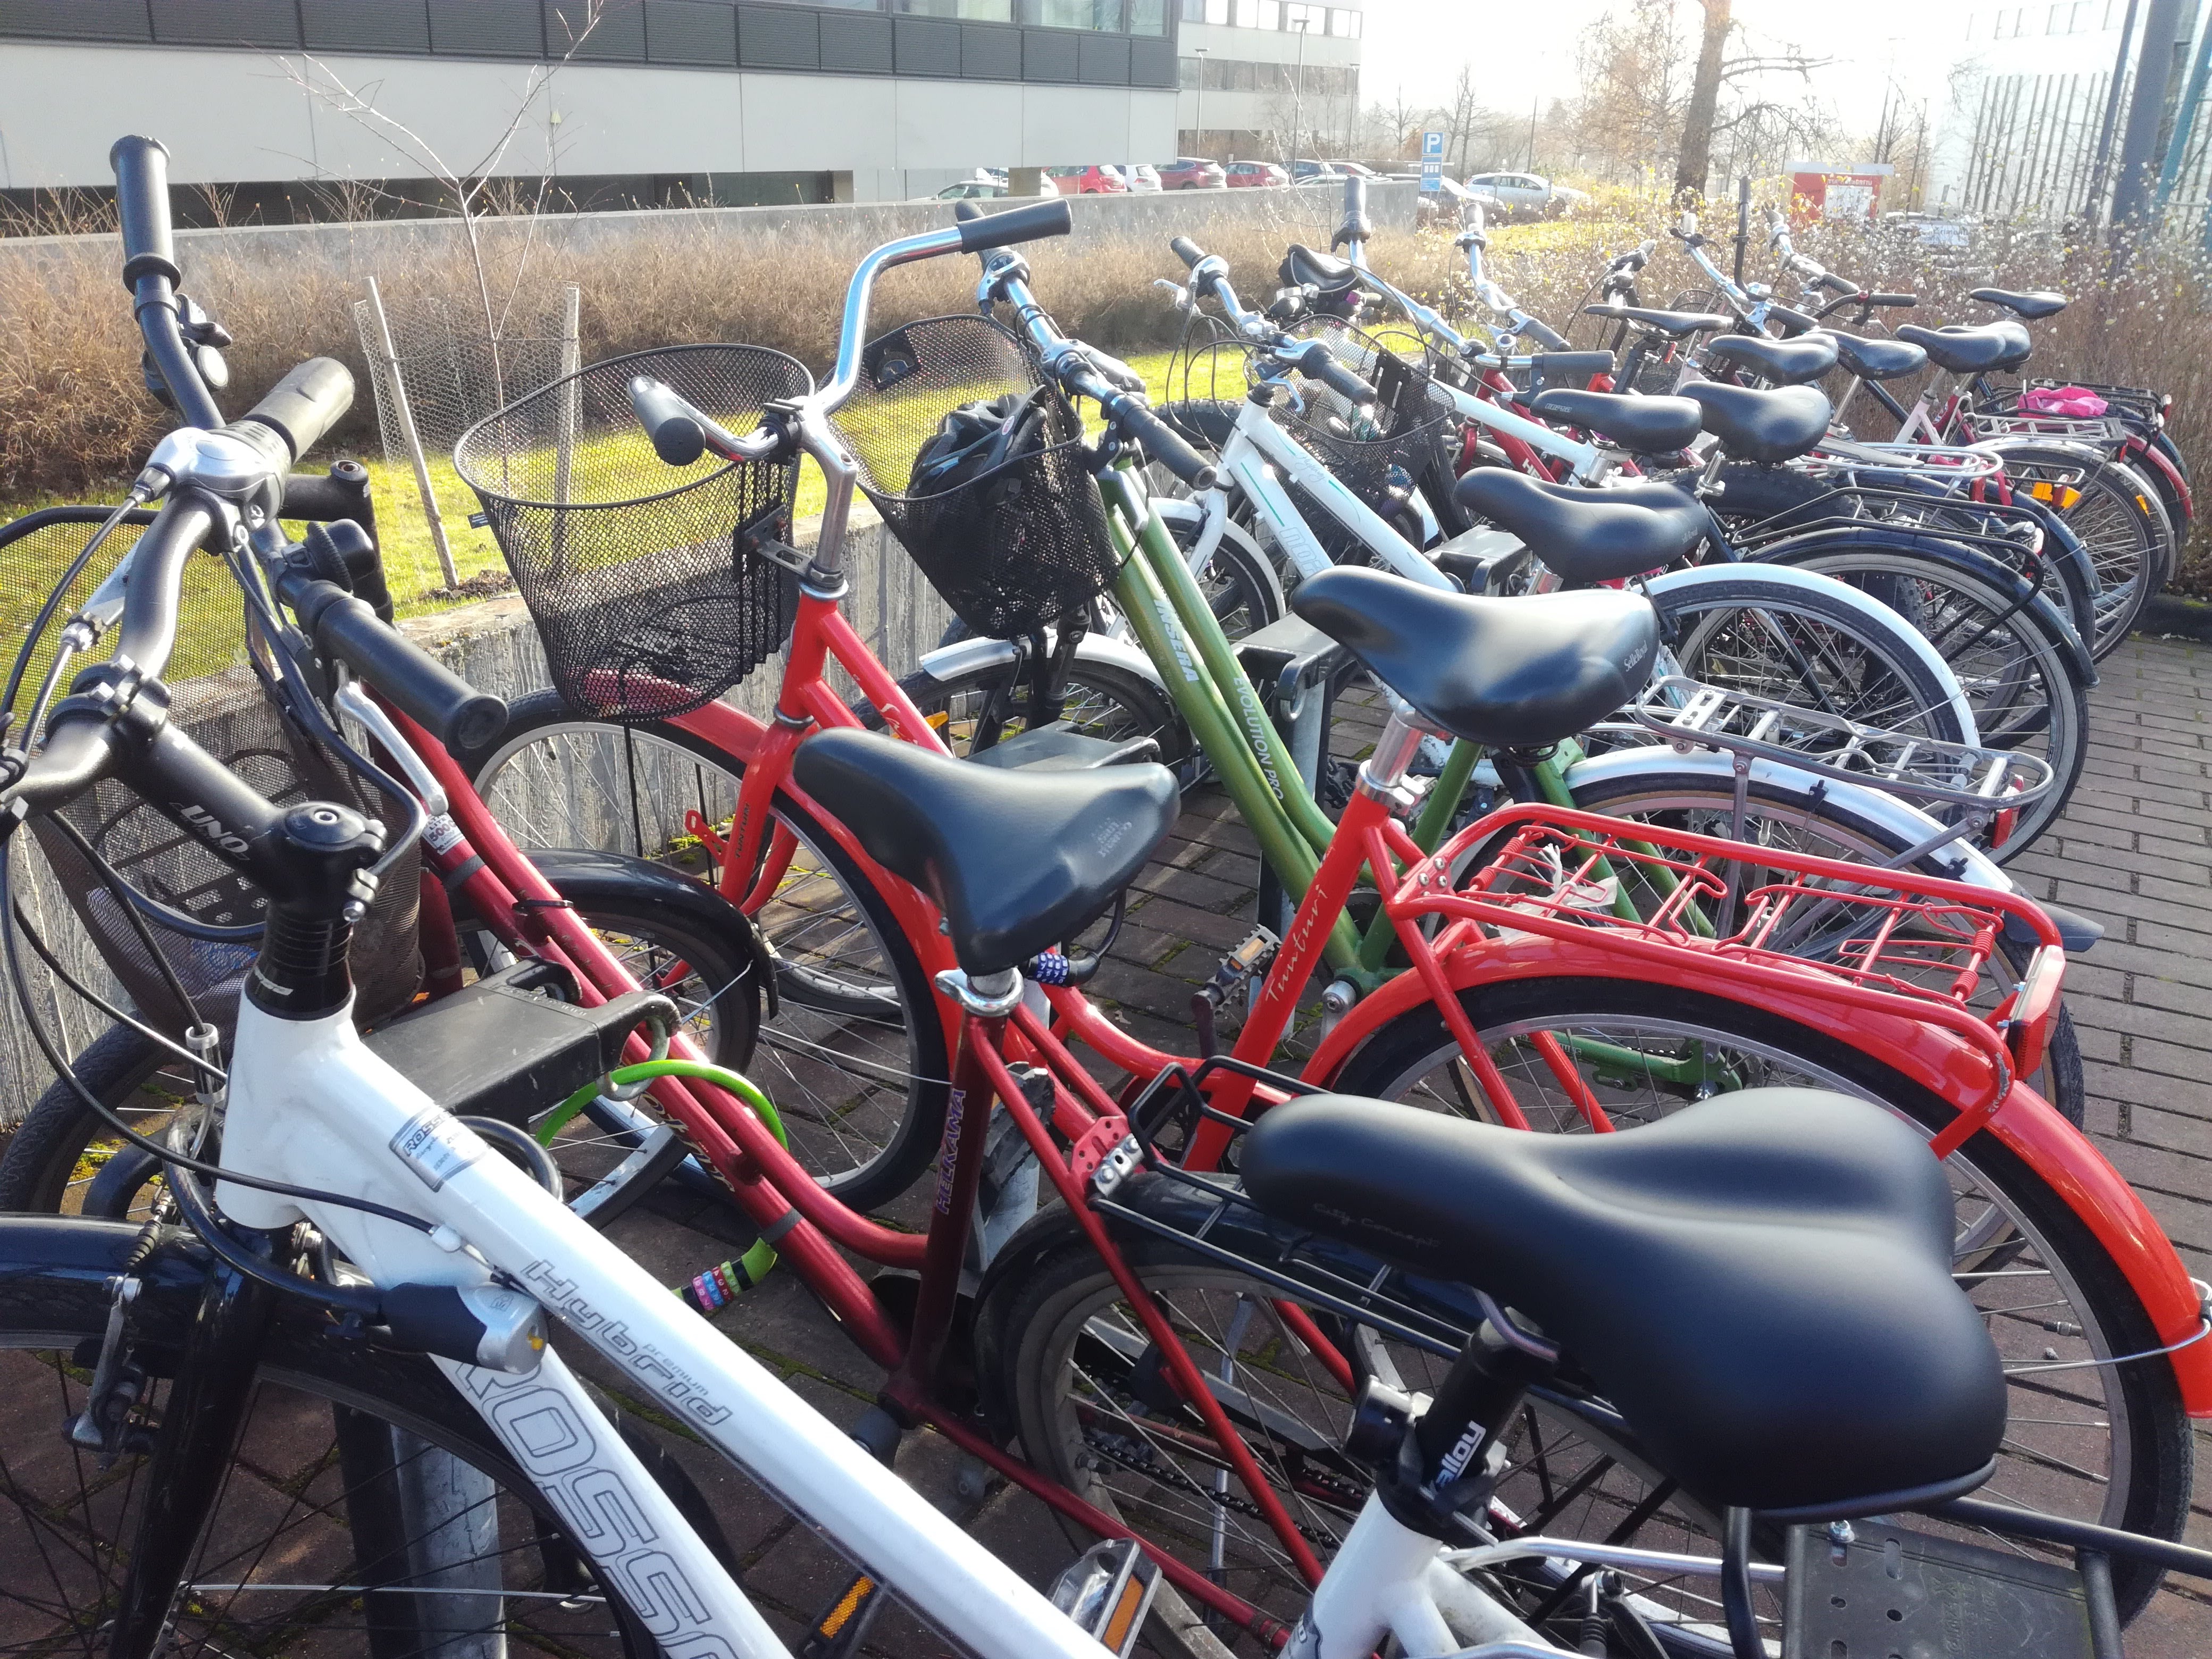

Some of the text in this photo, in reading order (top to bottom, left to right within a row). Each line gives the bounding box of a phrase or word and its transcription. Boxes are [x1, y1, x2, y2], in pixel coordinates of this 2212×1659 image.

[1427, 133, 1440, 153] P
[1153, 599, 1200, 682] INSERA
[1233, 677, 1273, 766] EVOLUTION
[1264, 768, 1284, 800] PRO
[180, 805, 249, 853] UNO
[1265, 884, 1328, 1002] Tunturi
[935, 1088, 967, 1216] HELKAMA
[521, 1259, 733, 1426] Hybrid
[642, 1343, 709, 1396] premium
[1430, 1420, 1487, 1490] alloy
